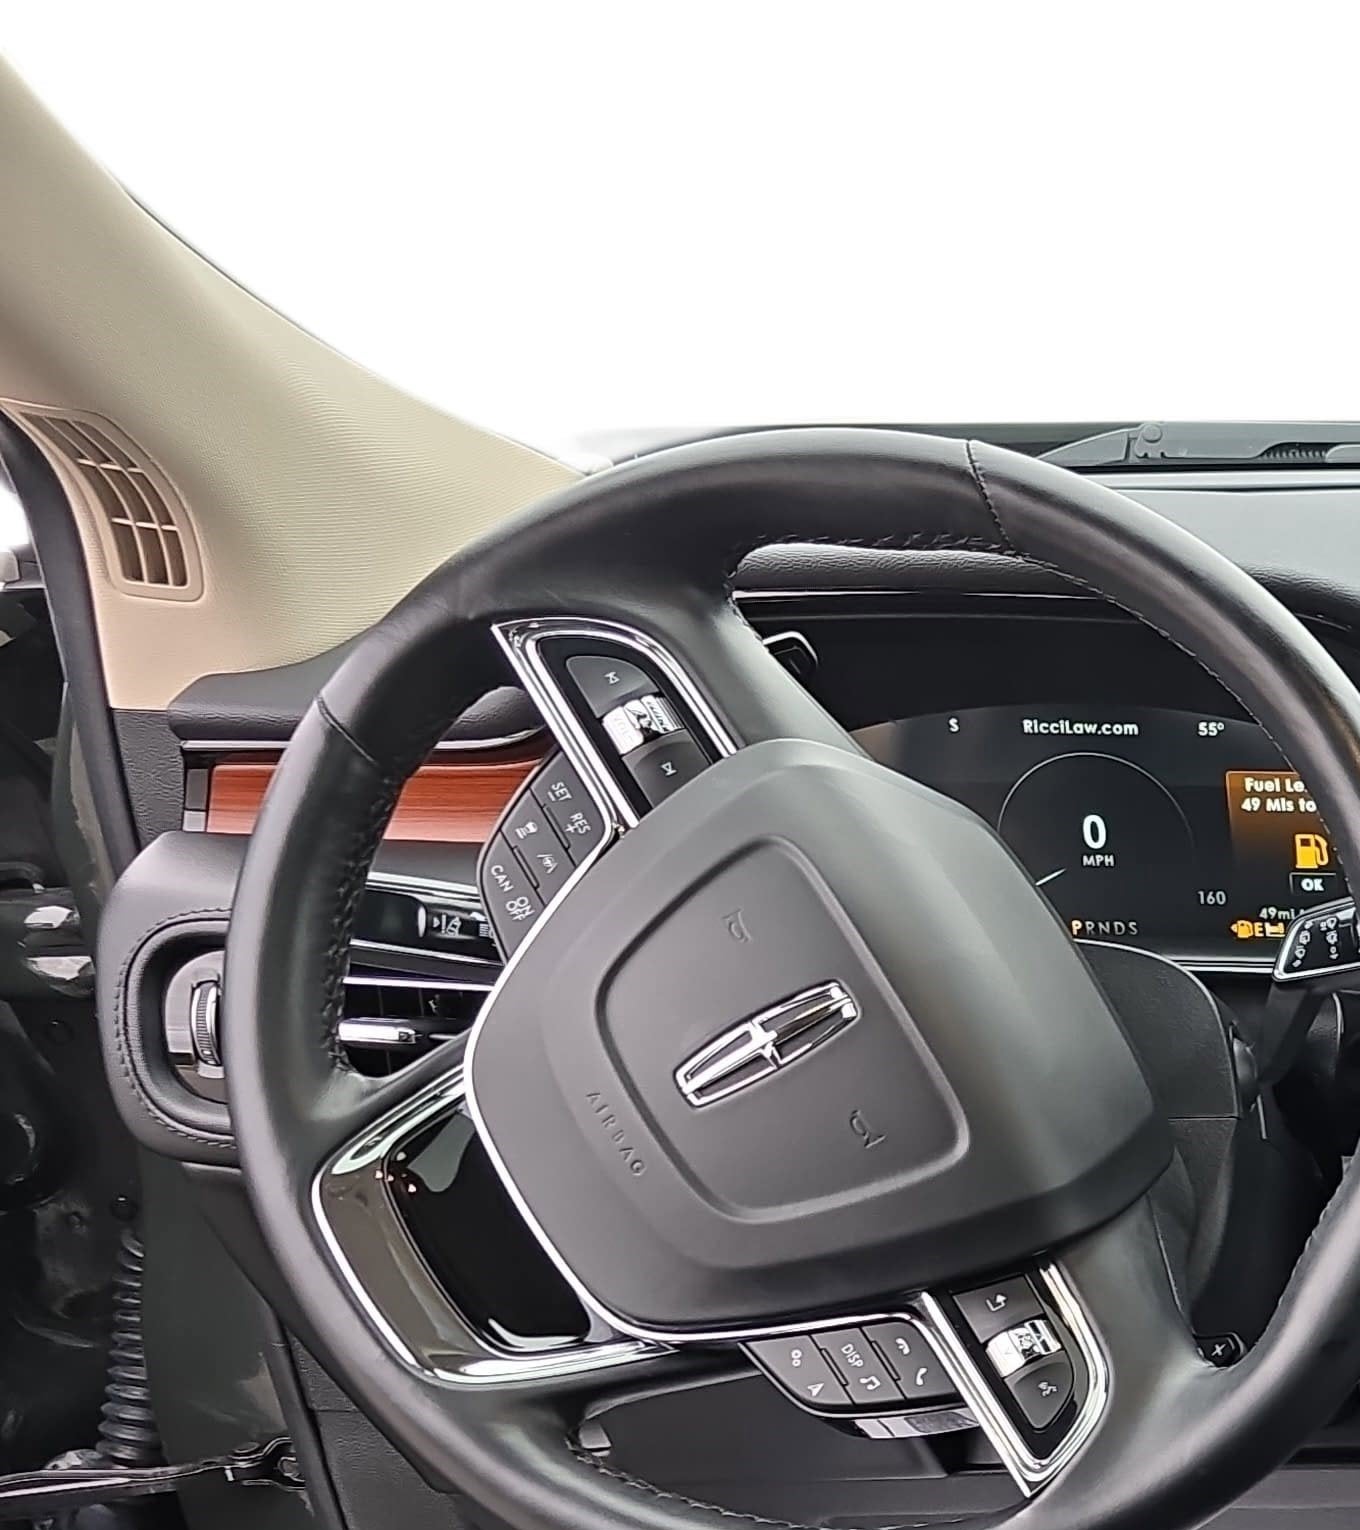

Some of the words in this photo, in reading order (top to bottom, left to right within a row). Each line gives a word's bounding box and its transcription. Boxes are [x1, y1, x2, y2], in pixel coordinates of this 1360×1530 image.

[949, 718, 960, 732] S
[1023, 719, 1139, 736] RicciLaw.com
[551, 781, 573, 802] SET
[1244, 777, 1281, 793] Fuel
[1241, 797, 1261, 812] 49
[1299, 798, 1317, 813] to
[570, 812, 591, 835] RES
[1082, 814, 1107, 849] 0
[1082, 855, 1115, 867] MPH
[491, 865, 514, 892] CAN
[1300, 878, 1325, 892] OK
[1197, 890, 1227, 905] 160
[586, 1091, 648, 1177] AIRBAG
[841, 1343, 864, 1368] DISP
